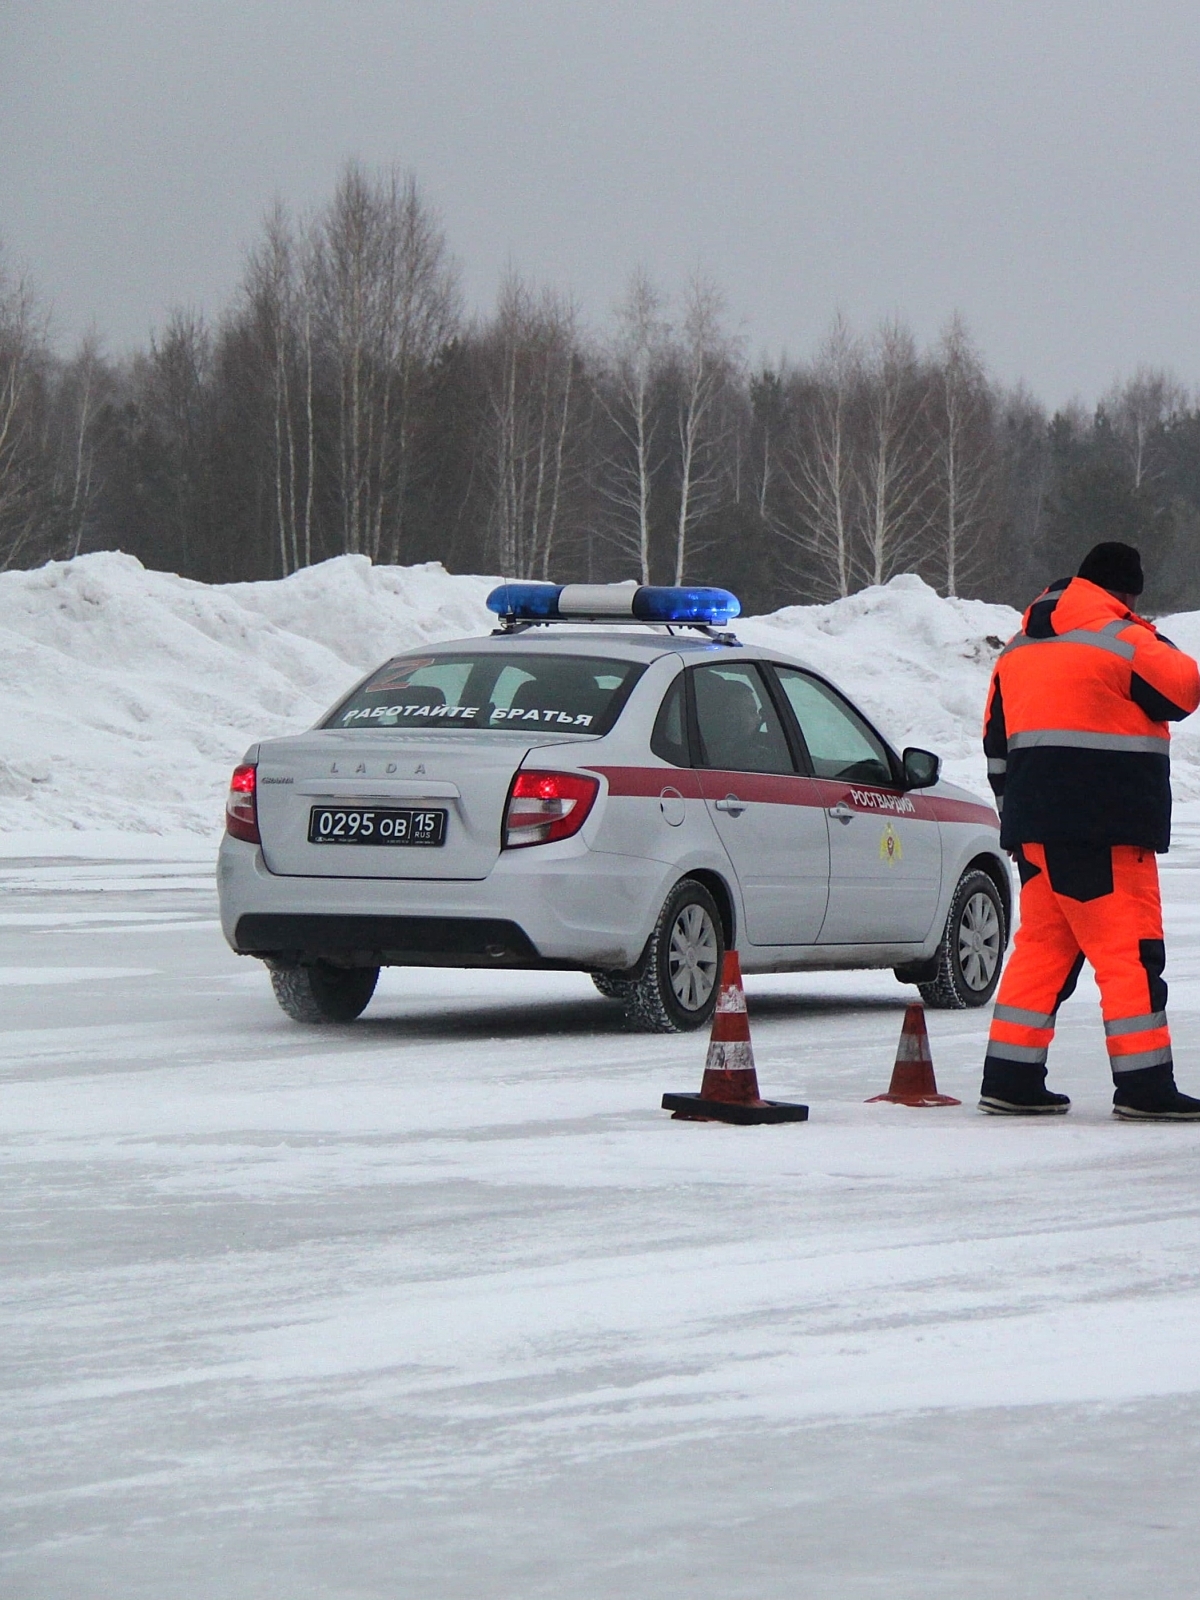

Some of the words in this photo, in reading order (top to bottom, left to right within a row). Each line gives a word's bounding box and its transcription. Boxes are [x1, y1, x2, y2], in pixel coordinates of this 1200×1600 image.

[342, 704, 480, 721] РАБОТАЙТЕ
[490, 708, 593, 726] БРАТЬЯ
[330, 762, 426, 774] LADA
[850, 789, 916, 814] РОСГВАРДИЯ
[320, 812, 375, 836] 0295
[414, 813, 436, 831] 15
